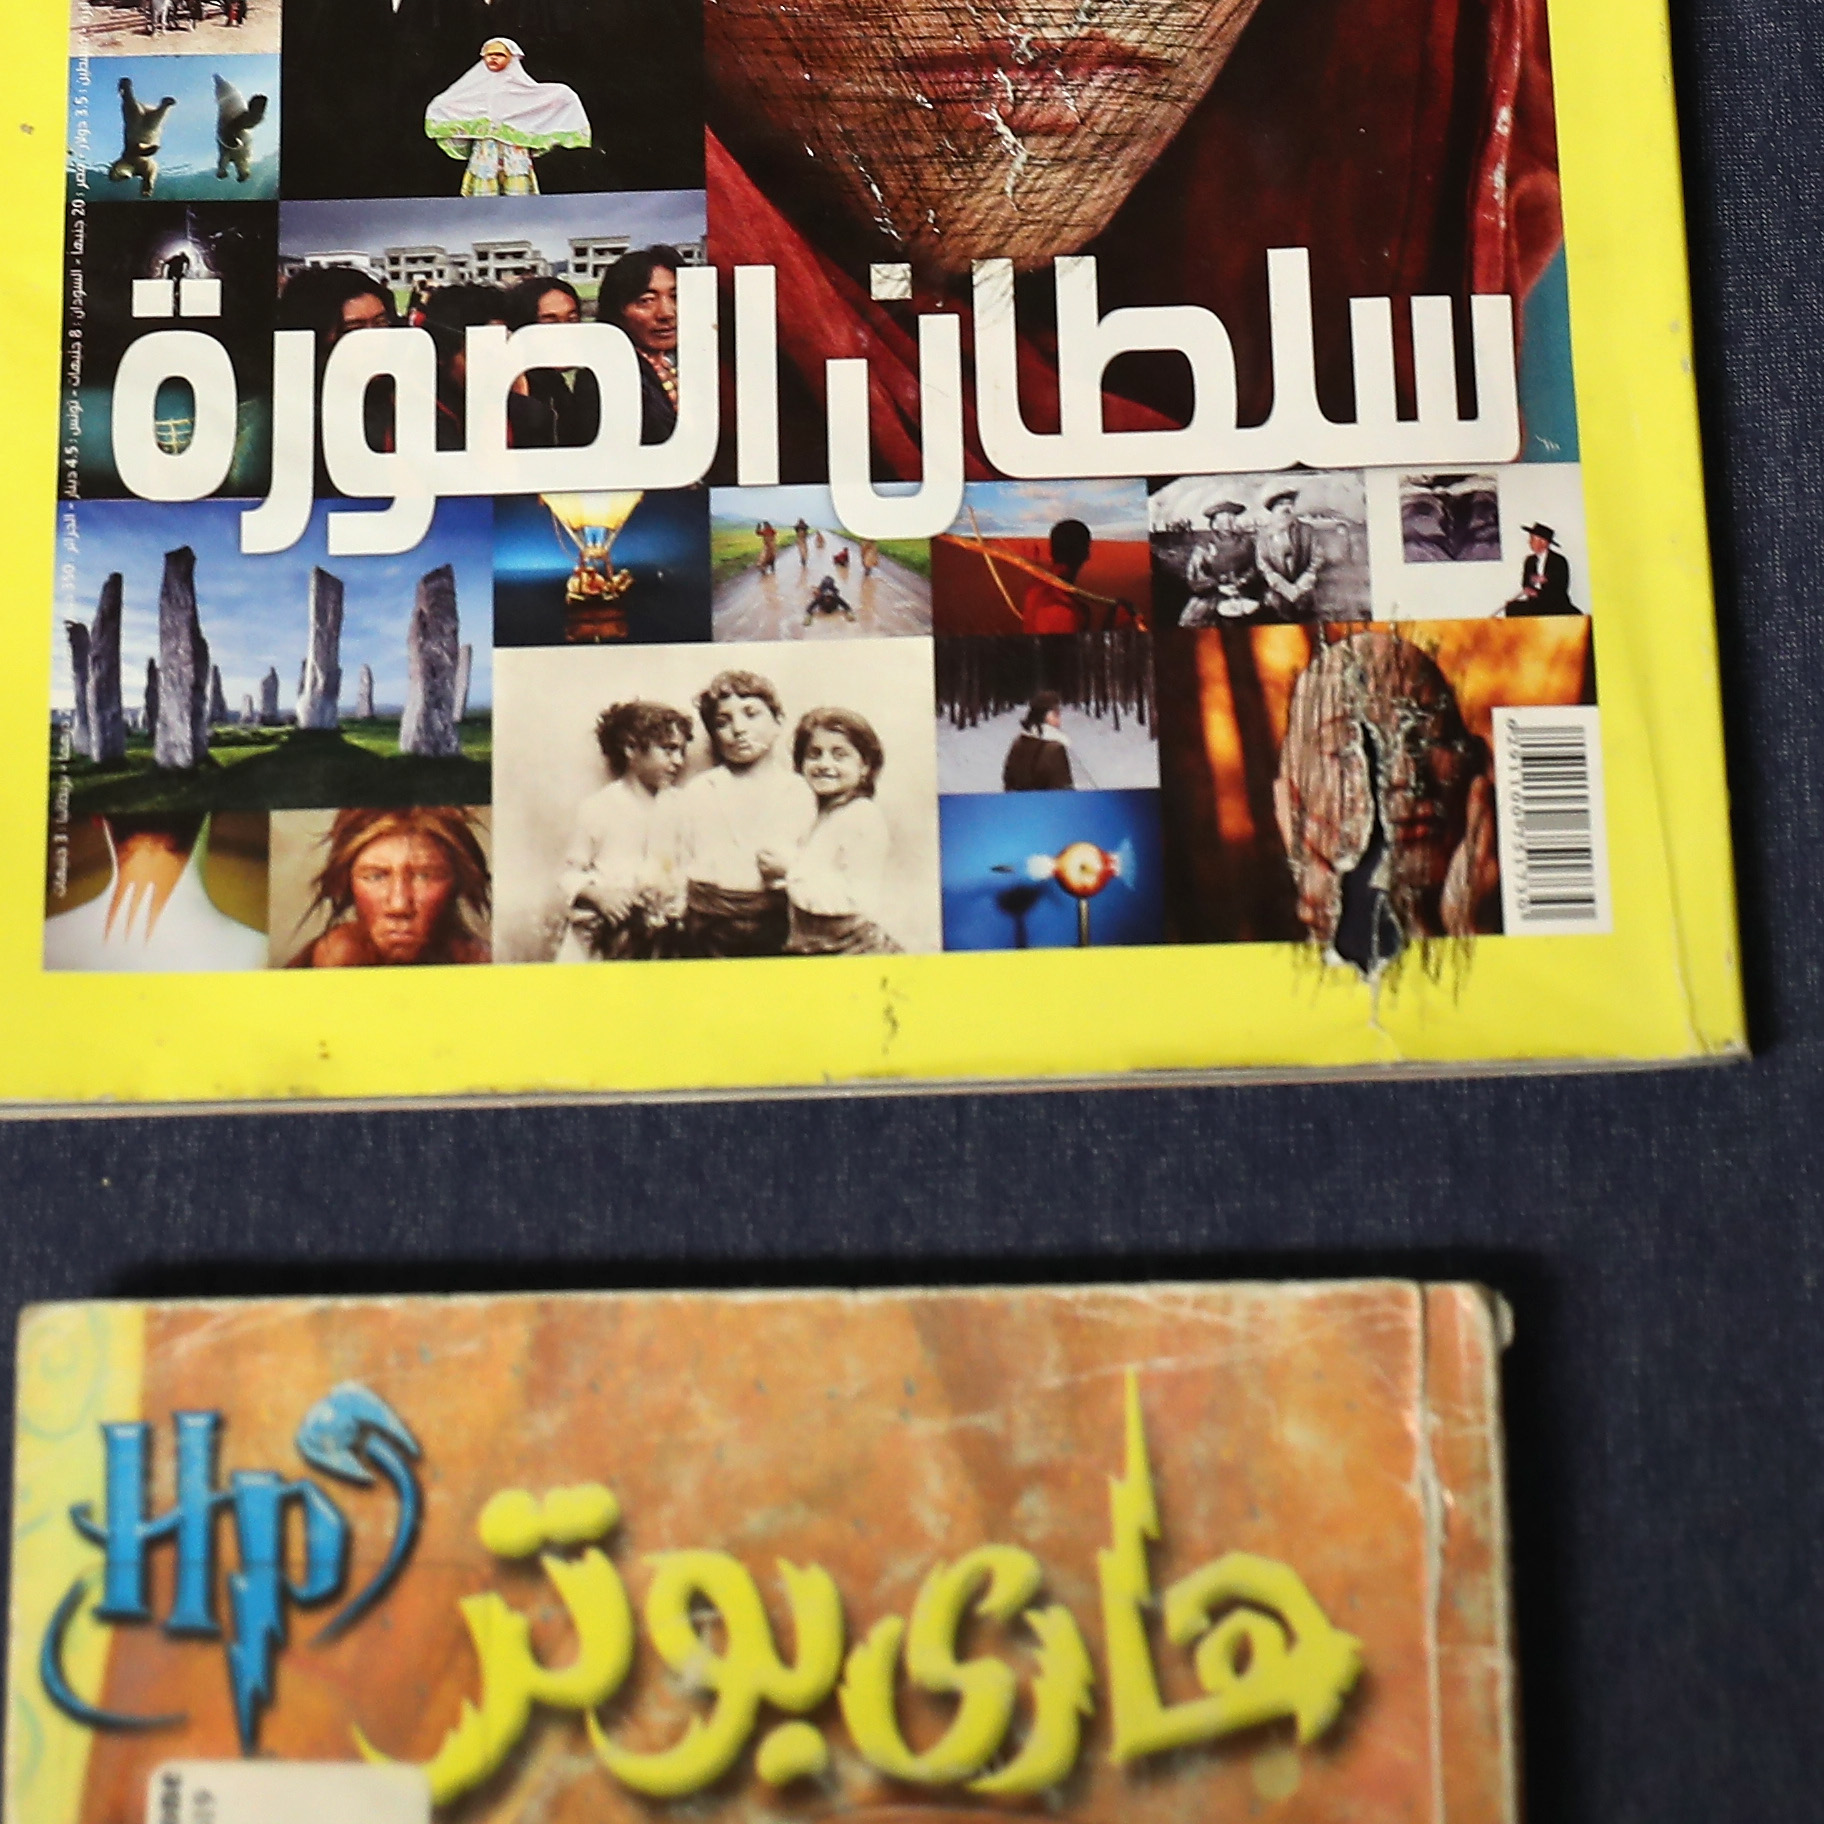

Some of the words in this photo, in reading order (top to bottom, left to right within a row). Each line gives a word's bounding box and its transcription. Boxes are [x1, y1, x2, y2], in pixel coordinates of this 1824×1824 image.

[70, 199, 89, 216] 20
[67, 268, 87, 319] السودان
[110, 264, 786, 557] الصورة
[826, 248, 1526, 539] سلطان
[64, 400, 83, 436] تونس
[63, 445, 82, 469] 4.5
